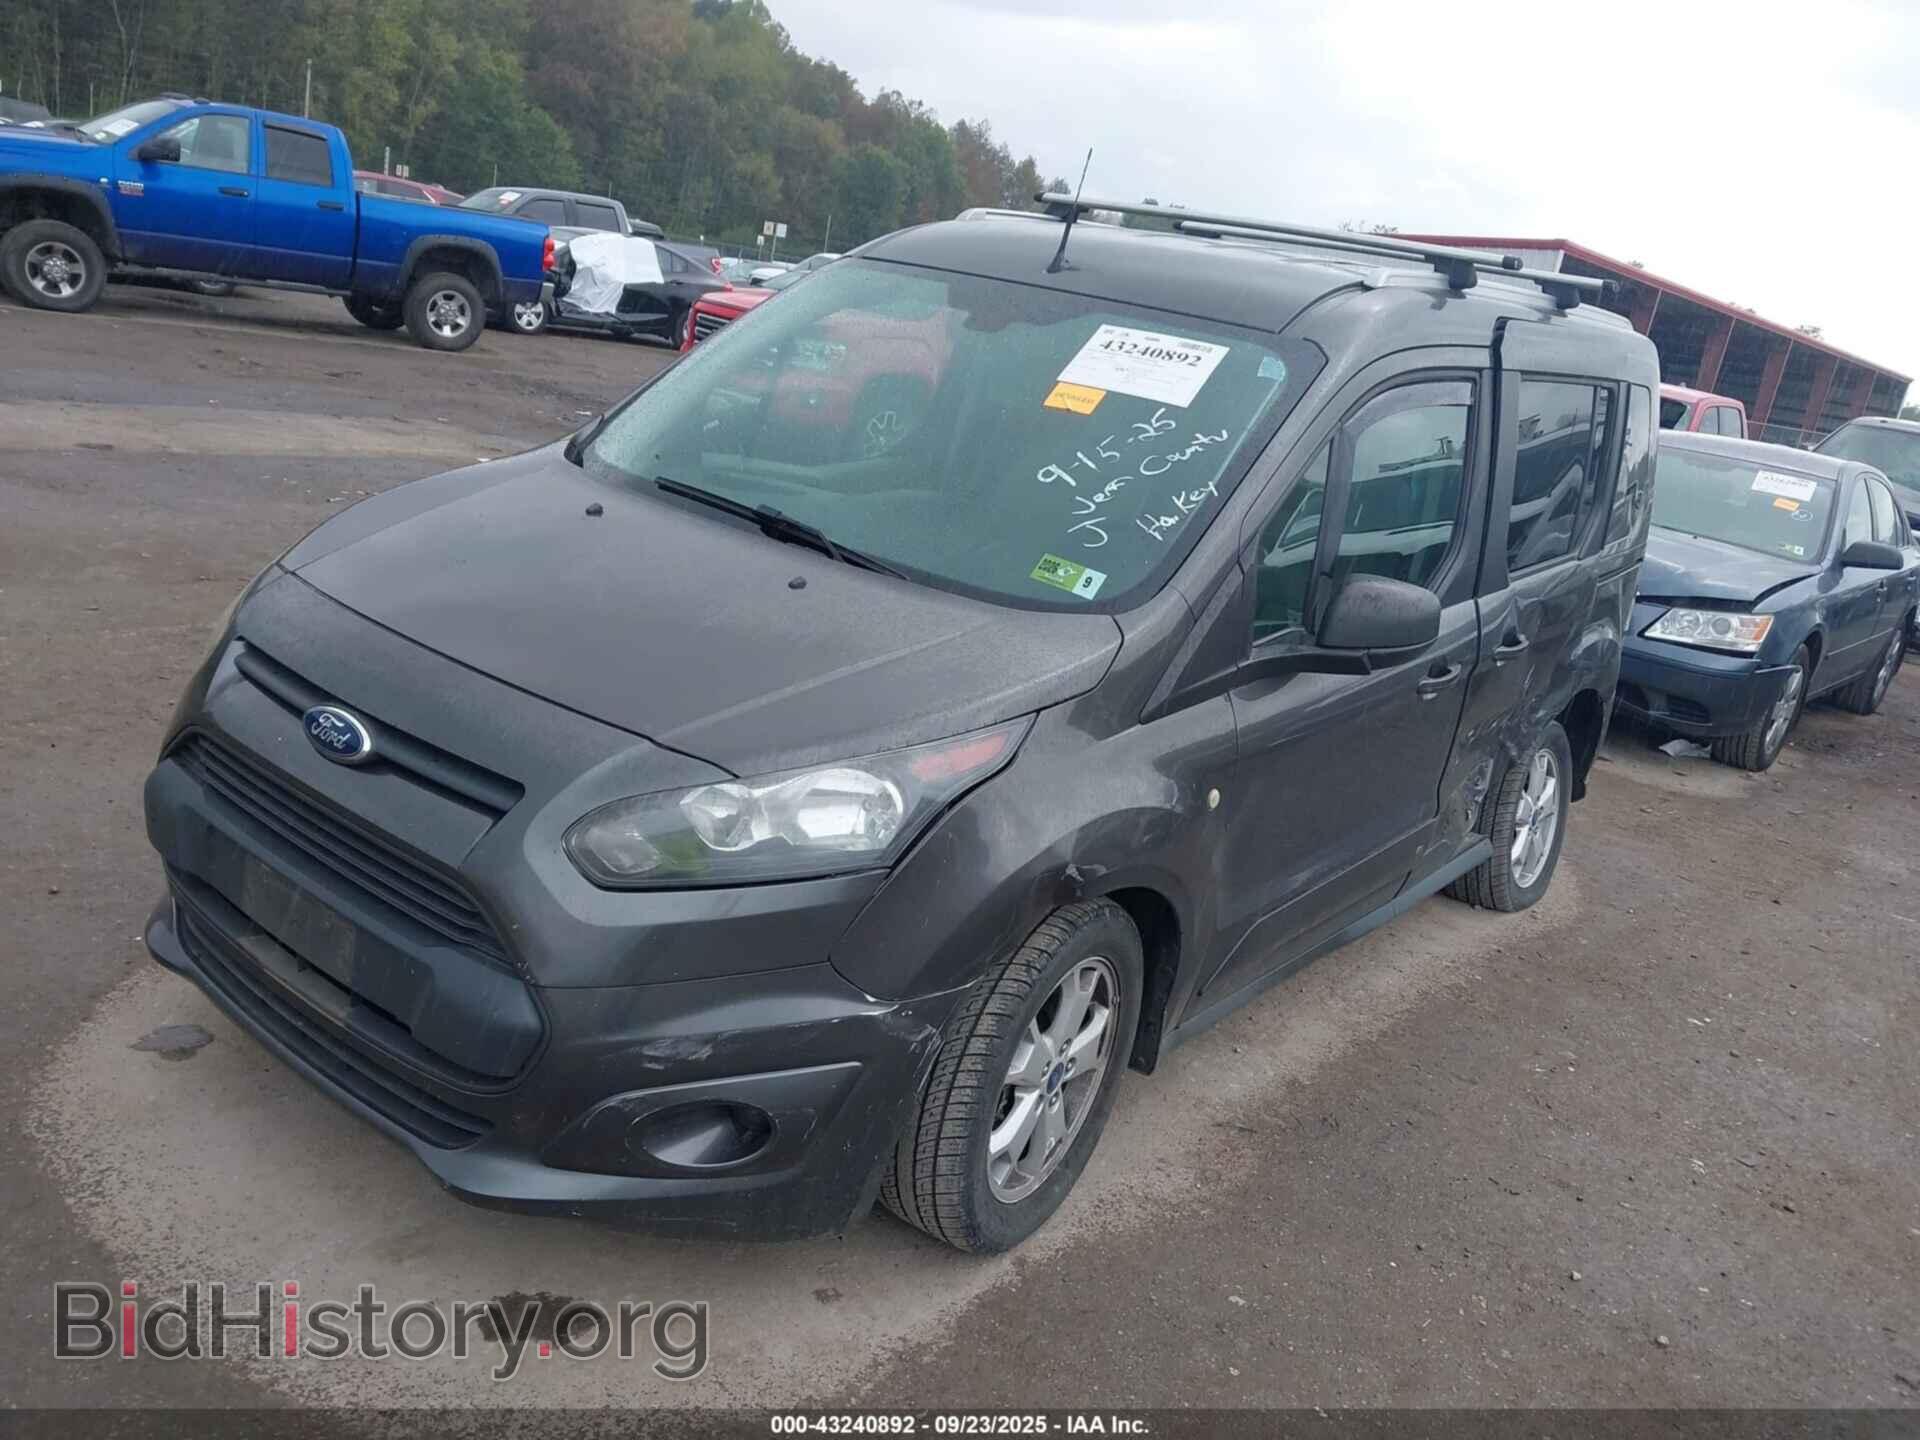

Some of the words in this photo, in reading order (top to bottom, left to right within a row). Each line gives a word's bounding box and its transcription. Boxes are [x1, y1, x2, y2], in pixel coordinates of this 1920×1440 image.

[1100, 339, 1203, 367] 43240892
[1171, 480, 1219, 514] Key
[1081, 575, 1093, 589] 9
[311, 712, 352, 750] Ford
